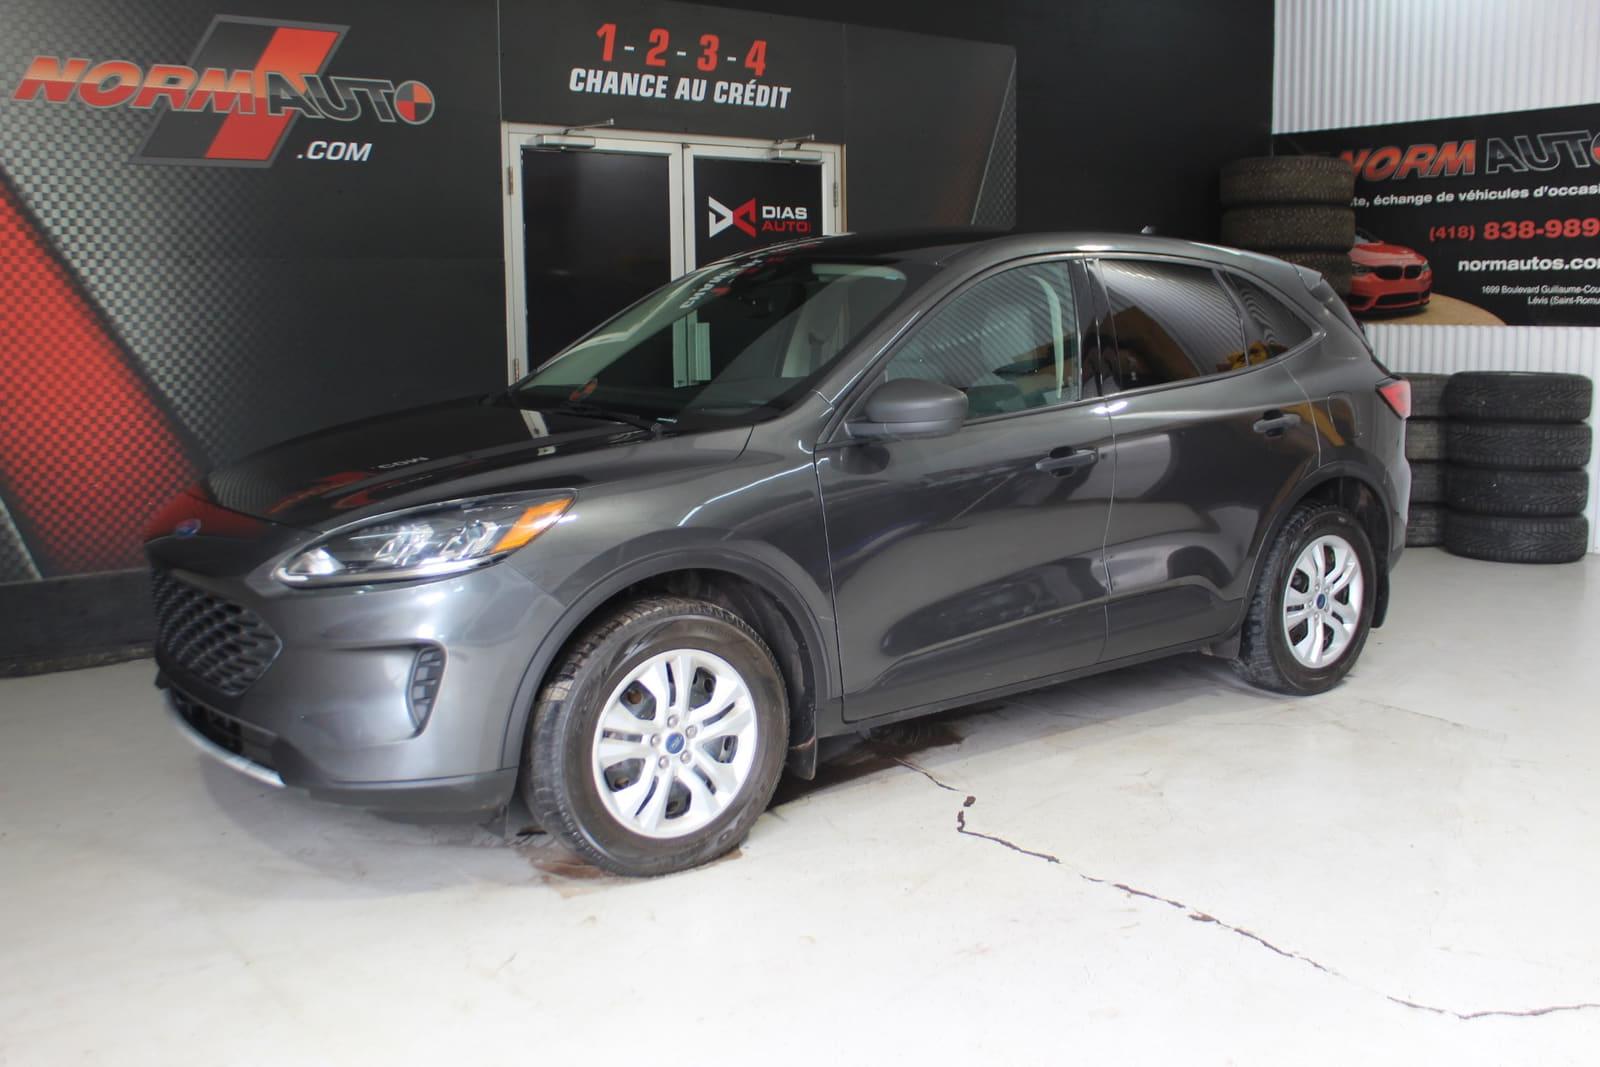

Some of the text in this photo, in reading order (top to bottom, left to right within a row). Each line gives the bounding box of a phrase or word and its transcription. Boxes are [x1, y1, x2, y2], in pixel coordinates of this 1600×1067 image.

[569, 67, 792, 109] CHANCE AU CRÉDIT
[1485, 129, 1600, 174] AUT
[1373, 190, 1434, 207] échange
[1436, 191, 1455, 203] de
[1458, 187, 1530, 202] véhicules
[762, 206, 807, 219] DIAS
[1429, 224, 1476, 241] (418)
[1482, 285, 1500, 294] 1699
[1501, 285, 1540, 294] Boulevard
